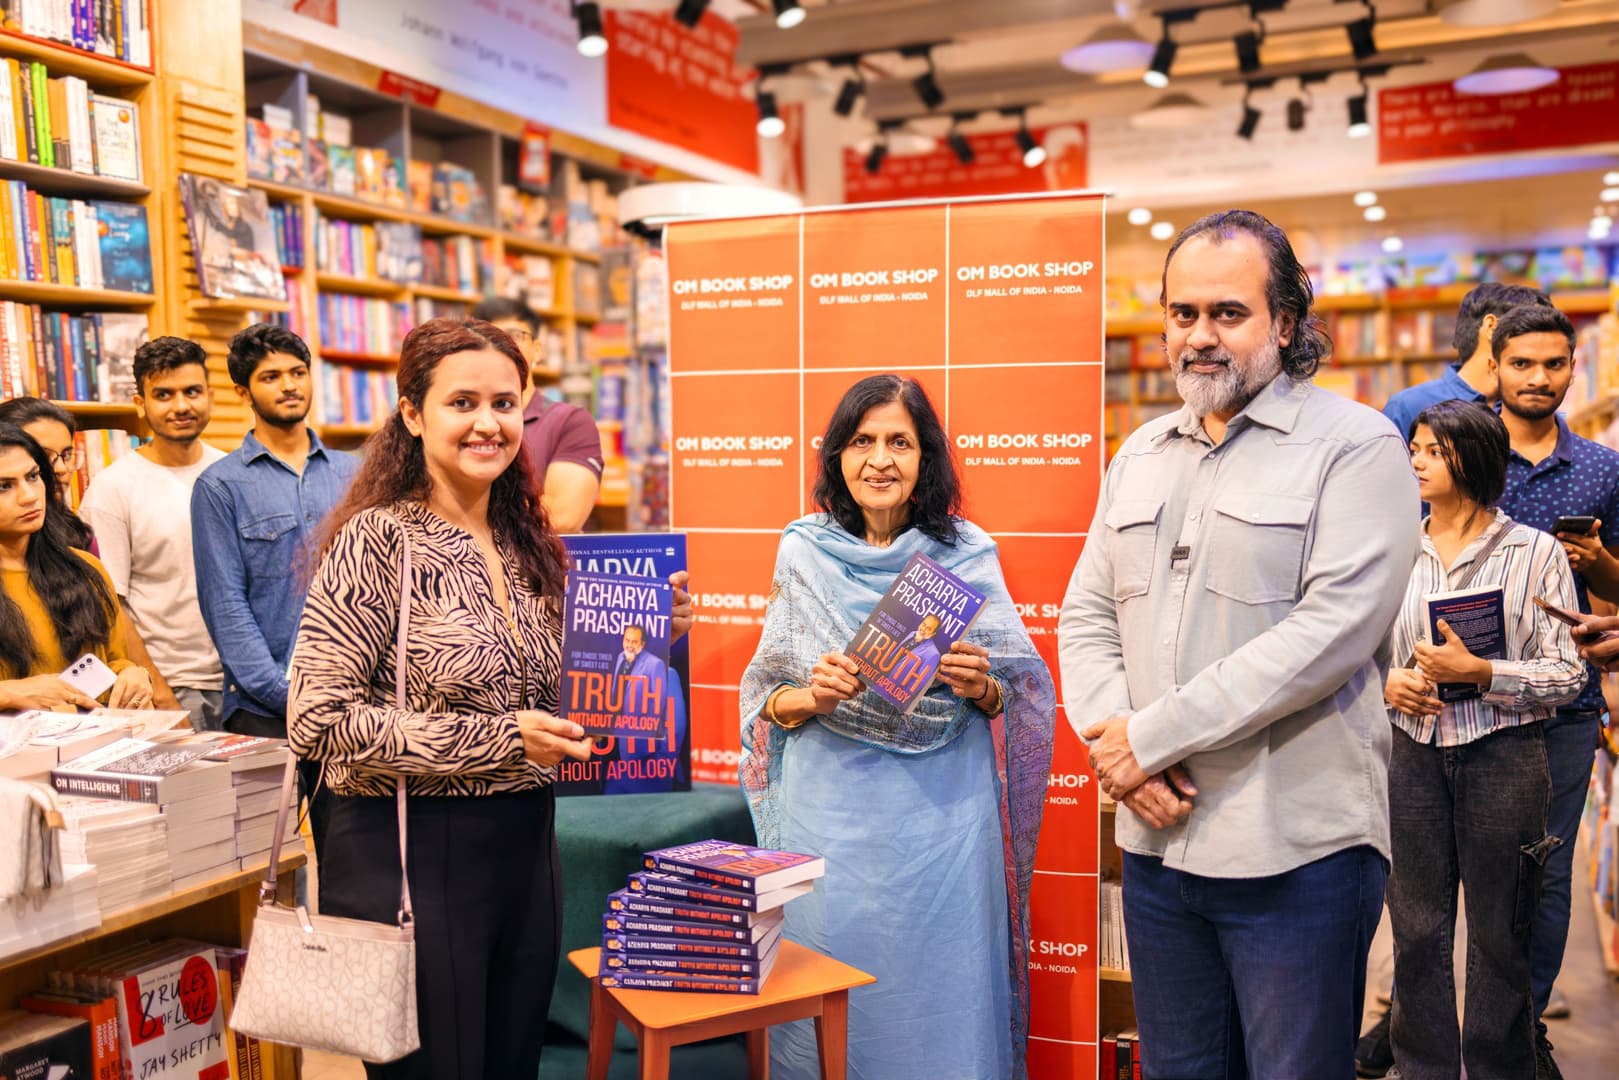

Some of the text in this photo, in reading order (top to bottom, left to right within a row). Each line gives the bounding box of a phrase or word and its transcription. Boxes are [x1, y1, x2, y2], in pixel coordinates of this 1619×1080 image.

[810, 268, 938, 288] OM BOOK SHOP
[957, 261, 1094, 281] OM BOOK SHOP
[673, 275, 793, 294] OM BOOK SHOP
[966, 289, 983, 298] DLF
[984, 287, 1008, 297] MALL
[1009, 287, 1021, 296] OF
[1023, 286, 1047, 295] INDIA
[1054, 284, 1083, 294] NOIDA
[860, 294, 872, 302] OF
[676, 436, 793, 451] OM BOOK SHOP
[956, 433, 1092, 448] OM BOOK SHOP
[965, 457, 982, 466] DLF
[983, 457, 1006, 466] MALL
[1007, 457, 1020, 466] OF
[1021, 457, 1046, 466] INDIA
[1052, 457, 1081, 465] NOIDA
[574, 582, 658, 612] ACHARYA
[904, 563, 969, 616] ACHARYA
[702, 593, 746, 609] BOOK
[892, 580, 966, 638] PRASHANT
[1014, 603, 1062, 618] OK SH
[573, 608, 669, 639] PRASHANT
[1027, 626, 1046, 635] DIA
[856, 623, 931, 693] TRUTH
[849, 652, 911, 704] WITHOUT APOLOGY
[567, 670, 663, 715] TRUTH
[567, 712, 660, 731] WITHOUT APOLOGY
[556, 761, 602, 782] HOUT
[606, 757, 678, 780] APOLOGY
[55, 778, 121, 794] ON INTELLIGENCE
[1047, 773, 1089, 788] HOP
[1050, 796, 1078, 805] NOIDA
[647, 883, 666, 893] ACHARYA
[666, 886, 688, 897] PRASHANT
[629, 902, 650, 912] ACHARYA
[650, 905, 674, 914] PRASHANT
[626, 921, 648, 930] ACHARYA
[648, 923, 673, 932] PRASHANT
[1040, 940, 1088, 957] SHOP
[1028, 962, 1042, 971] DIA
[1048, 964, 1077, 974] NOIDA
[136, 990, 157, 1039] 8
[159, 971, 208, 1005] RULES
[162, 992, 211, 1026] OF LOVE
[140, 1054, 166, 1080] JAY
[171, 1032, 221, 1069] SHETTY
[15, 1057, 49, 1075] MARGARET
